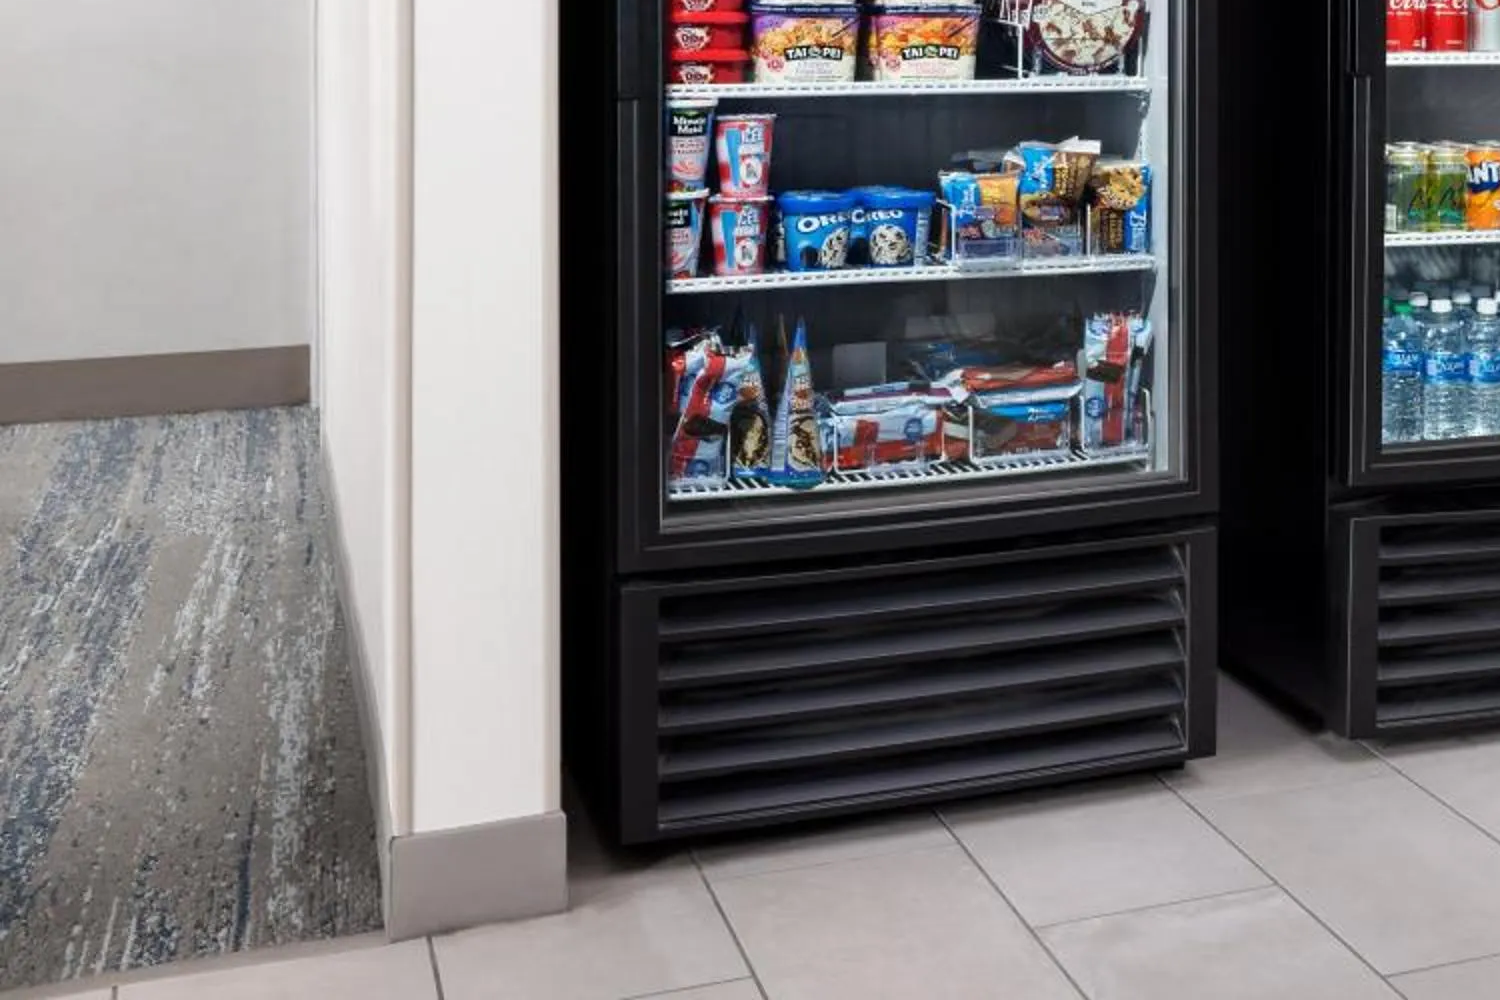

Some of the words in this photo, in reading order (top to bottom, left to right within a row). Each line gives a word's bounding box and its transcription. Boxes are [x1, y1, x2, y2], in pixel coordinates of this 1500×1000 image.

[785, 47, 807, 60] TAI
[822, 47, 841, 58] PEI
[903, 47, 924, 60] TAI
[939, 47, 960, 59] PEI
